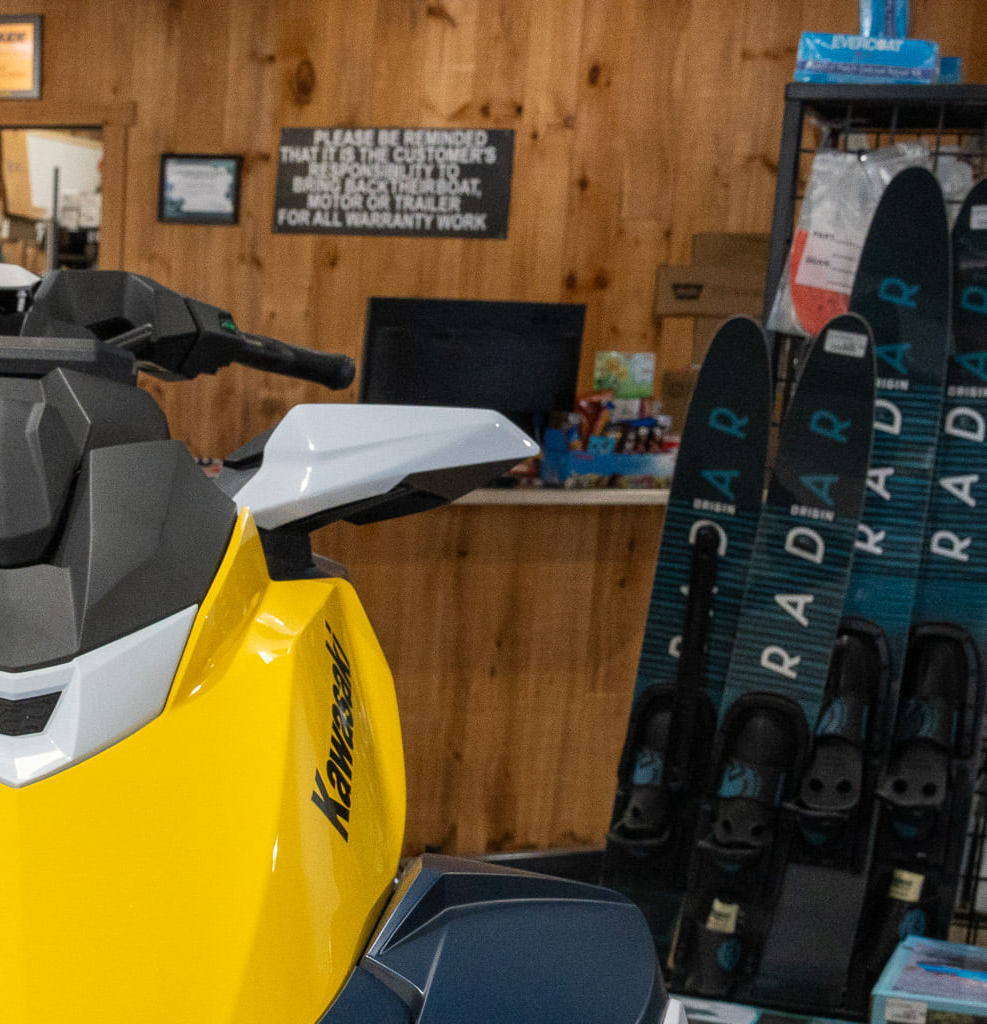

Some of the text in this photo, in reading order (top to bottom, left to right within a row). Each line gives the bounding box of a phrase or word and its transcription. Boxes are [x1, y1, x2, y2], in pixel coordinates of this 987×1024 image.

[314, 129, 488, 147] PLEASE BE REMINDED
[280, 146, 497, 164] THAT IT IS THE CUSTOMER'S
[438, 164, 460, 179] TO
[345, 177, 388, 194] BACK
[307, 194, 461, 212] MOTOR OR TRAILER
[277, 209, 487, 231] FOR ALL WARRANTY WORK
[693, 498, 736, 516] ORIGIN
[790, 503, 834, 522] ORIGIN
[760, 409, 851, 679] RADAR
[311, 619, 354, 843] Kawasaki
